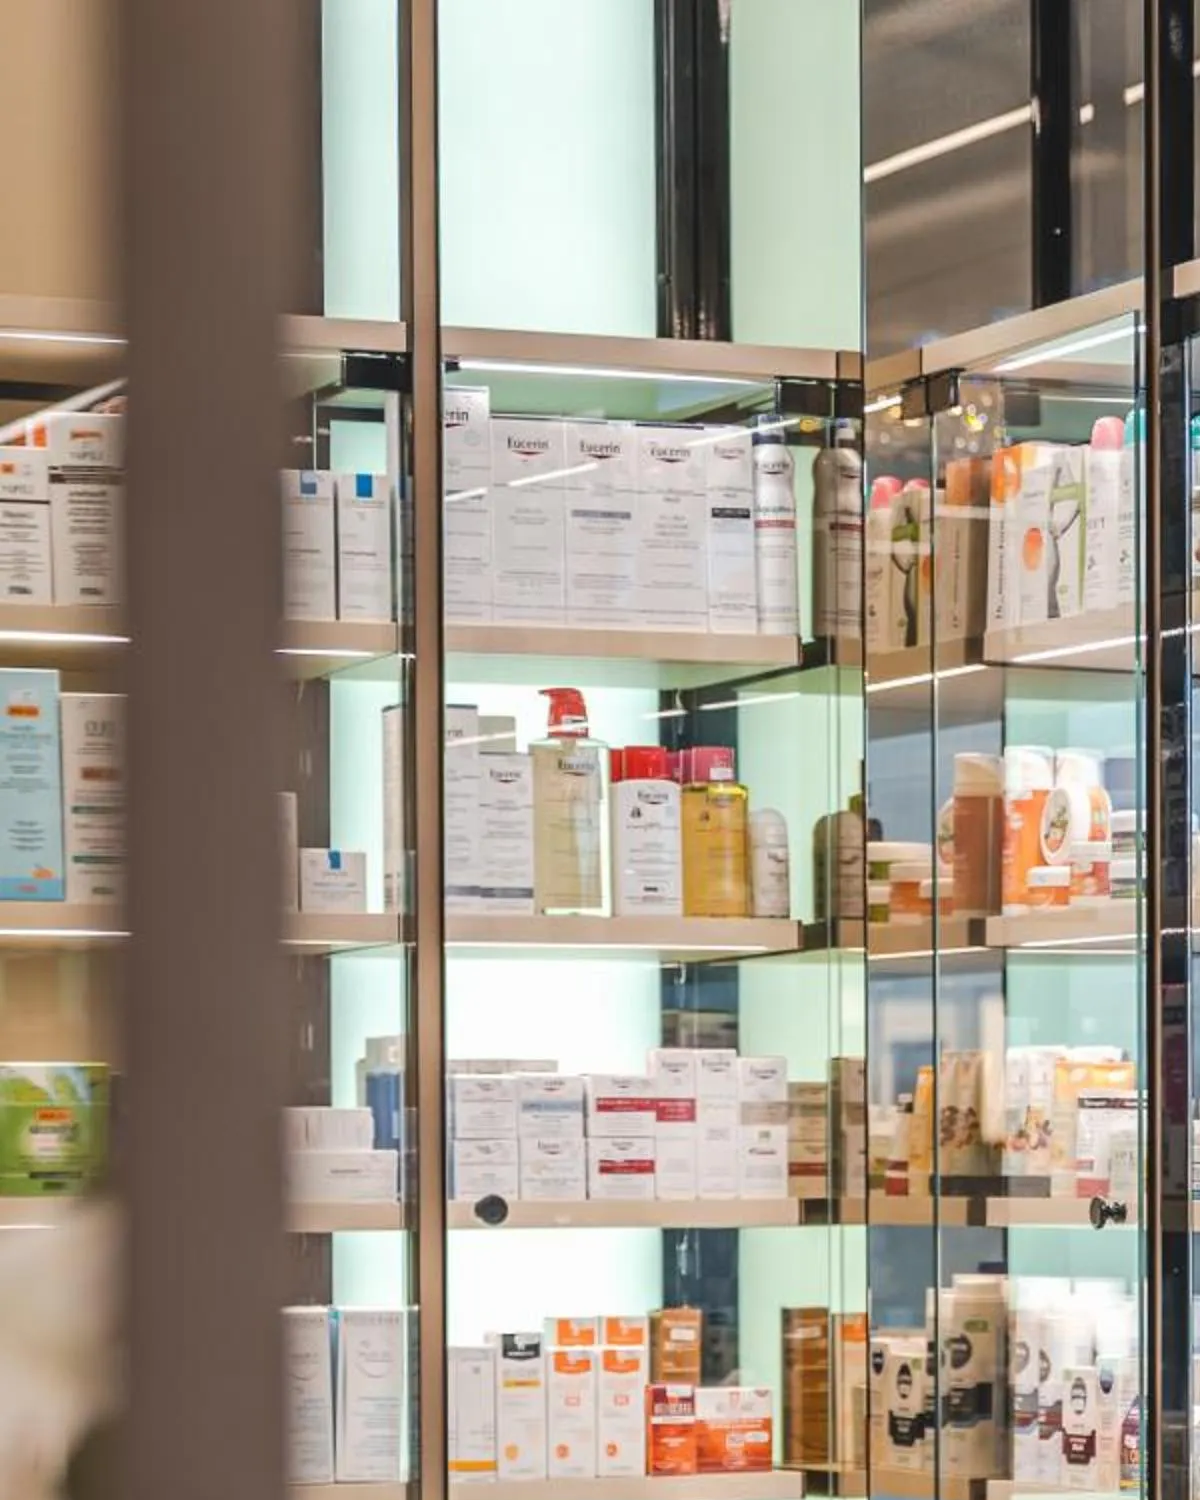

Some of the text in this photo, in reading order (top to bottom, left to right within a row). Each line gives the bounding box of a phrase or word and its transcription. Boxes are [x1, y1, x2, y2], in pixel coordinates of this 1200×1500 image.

[507, 436, 550, 449] Eucerin
[579, 440, 621, 453] Eucerin
[650, 446, 691, 458] Eucerin
